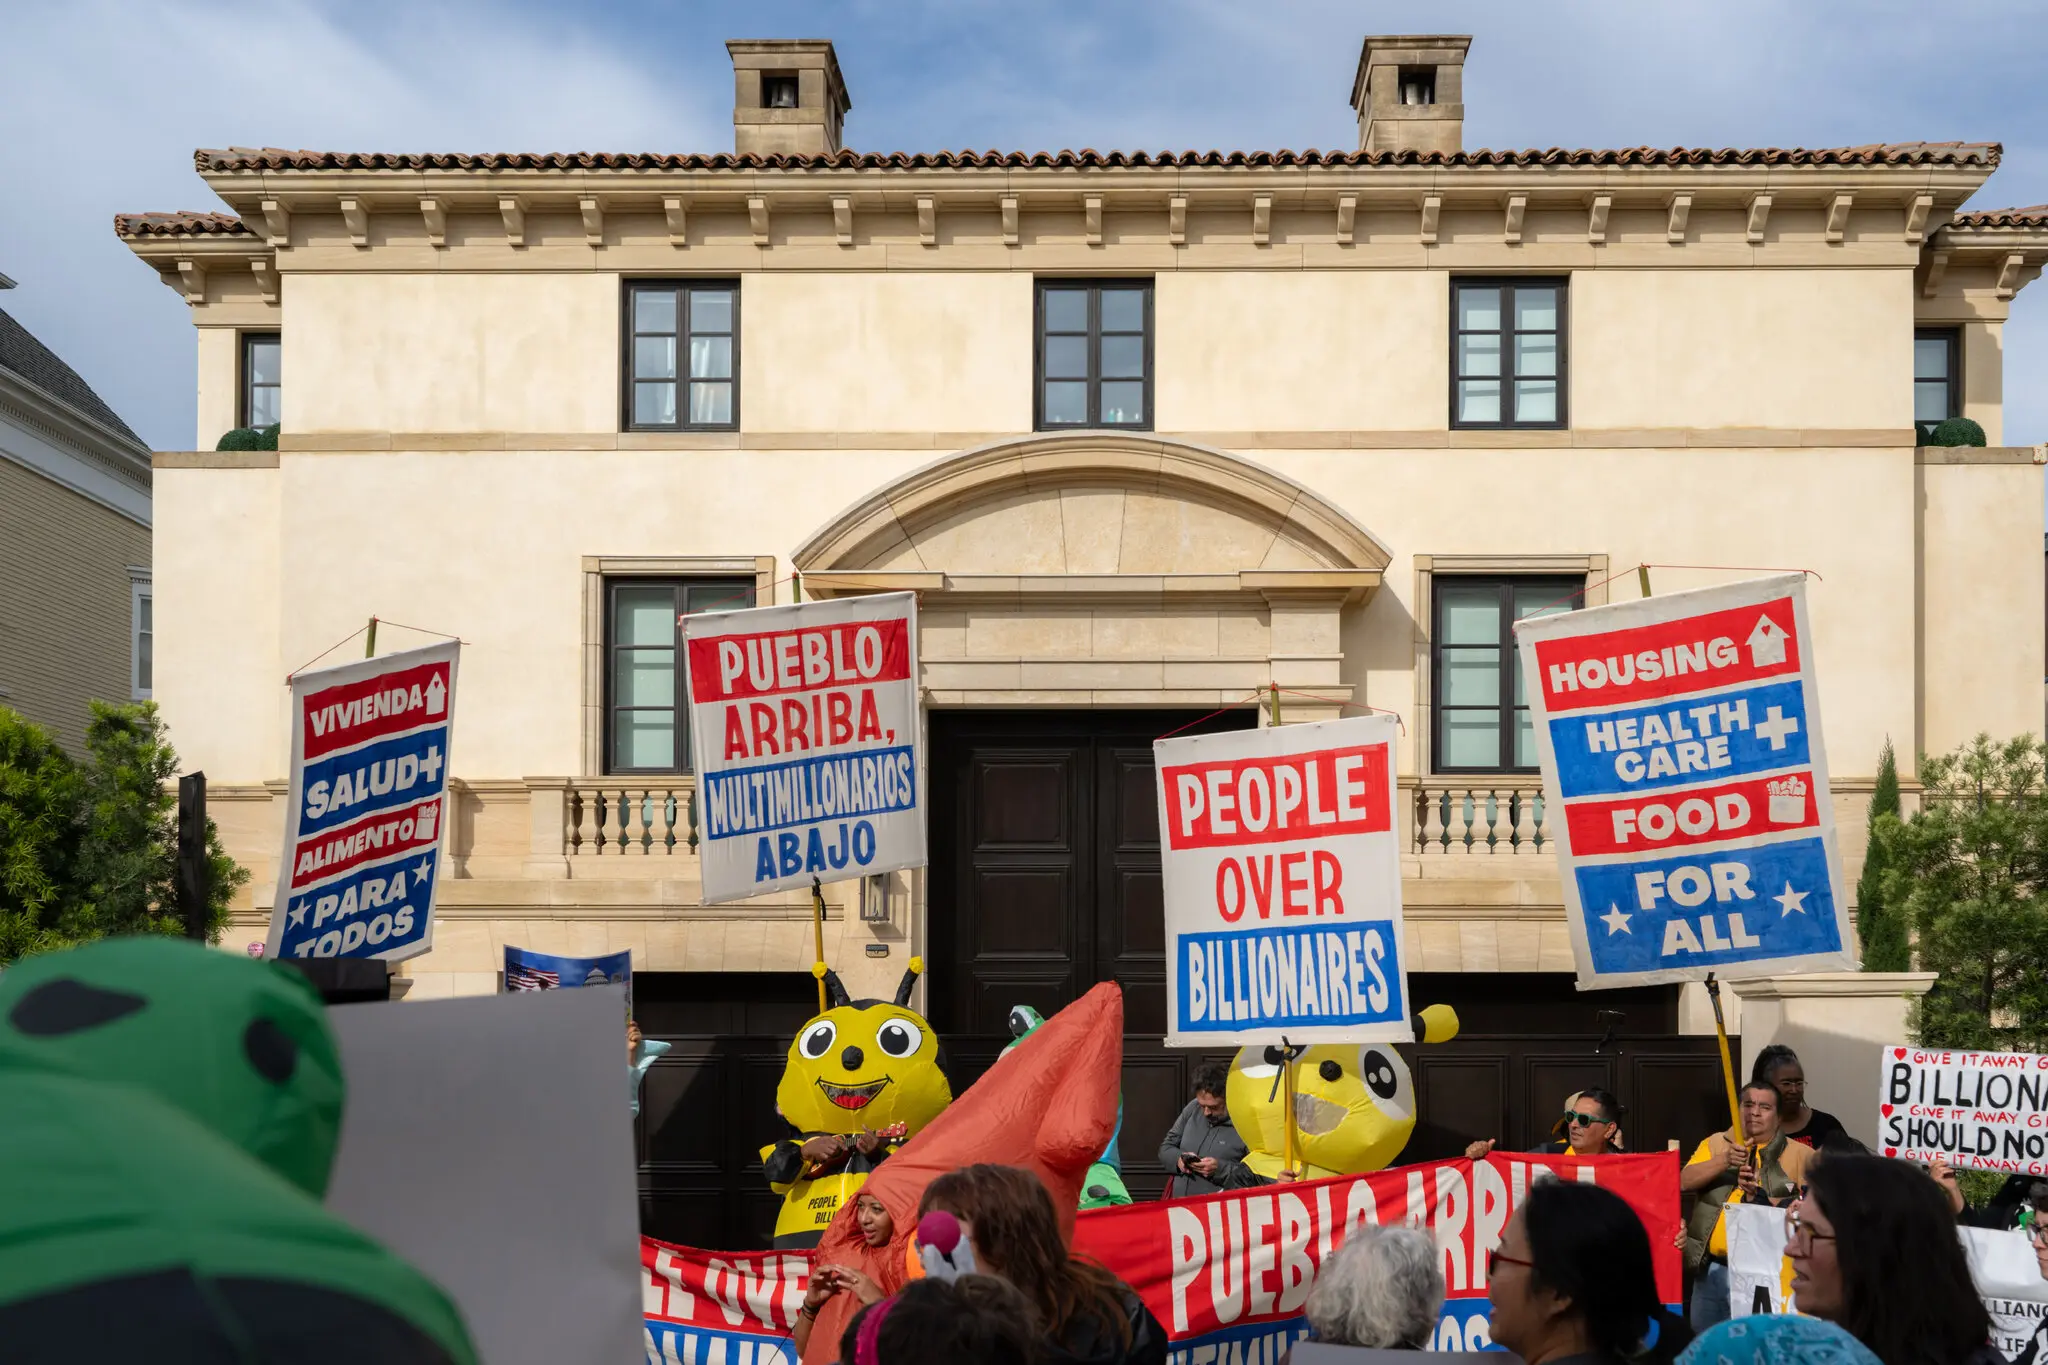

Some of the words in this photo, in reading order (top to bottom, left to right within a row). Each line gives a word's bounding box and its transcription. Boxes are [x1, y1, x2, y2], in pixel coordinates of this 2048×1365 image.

[718, 626, 883, 694] PUEBLO
[1549, 636, 1739, 693] HOUSING
[310, 684, 424, 737] VIVIENDA
[724, 689, 895, 760] ARRIBA,
[1585, 699, 1750, 753] HEALTH
[306, 754, 418, 819] SALUD
[1614, 736, 1732, 783] CARE
[708, 752, 912, 836] MULTIMILLONARIOS
[1177, 755, 1366, 836] PEOPLE
[1612, 792, 1751, 844] FOOD
[295, 818, 414, 877] ALIMENTO
[755, 820, 876, 882] ABAJO
[312, 871, 407, 929] PARA
[1216, 850, 1344, 923] OVER
[1635, 861, 1755, 911] FOR
[294, 905, 415, 958] TODOS
[1661, 913, 1760, 957] ALL
[1188, 929, 1389, 1022] BILLIONAIRES
[1913, 1052, 1952, 1065] GIVE
[1885, 1115, 1996, 1156] SHOULD
[1910, 1104, 1944, 1119] GIVE
[1952, 1109, 1965, 1119] IT
[1973, 1111, 2018, 1125] AWAY
[1905, 1149, 1945, 1161] GIVE
[1953, 1154, 1966, 1166] IT
[1971, 1155, 2022, 1173] AWAY
[808, 1195, 837, 1210] PEOPLE
[1406, 1159, 1596, 1292] ARR
[704, 1254, 816, 1331] OVE
